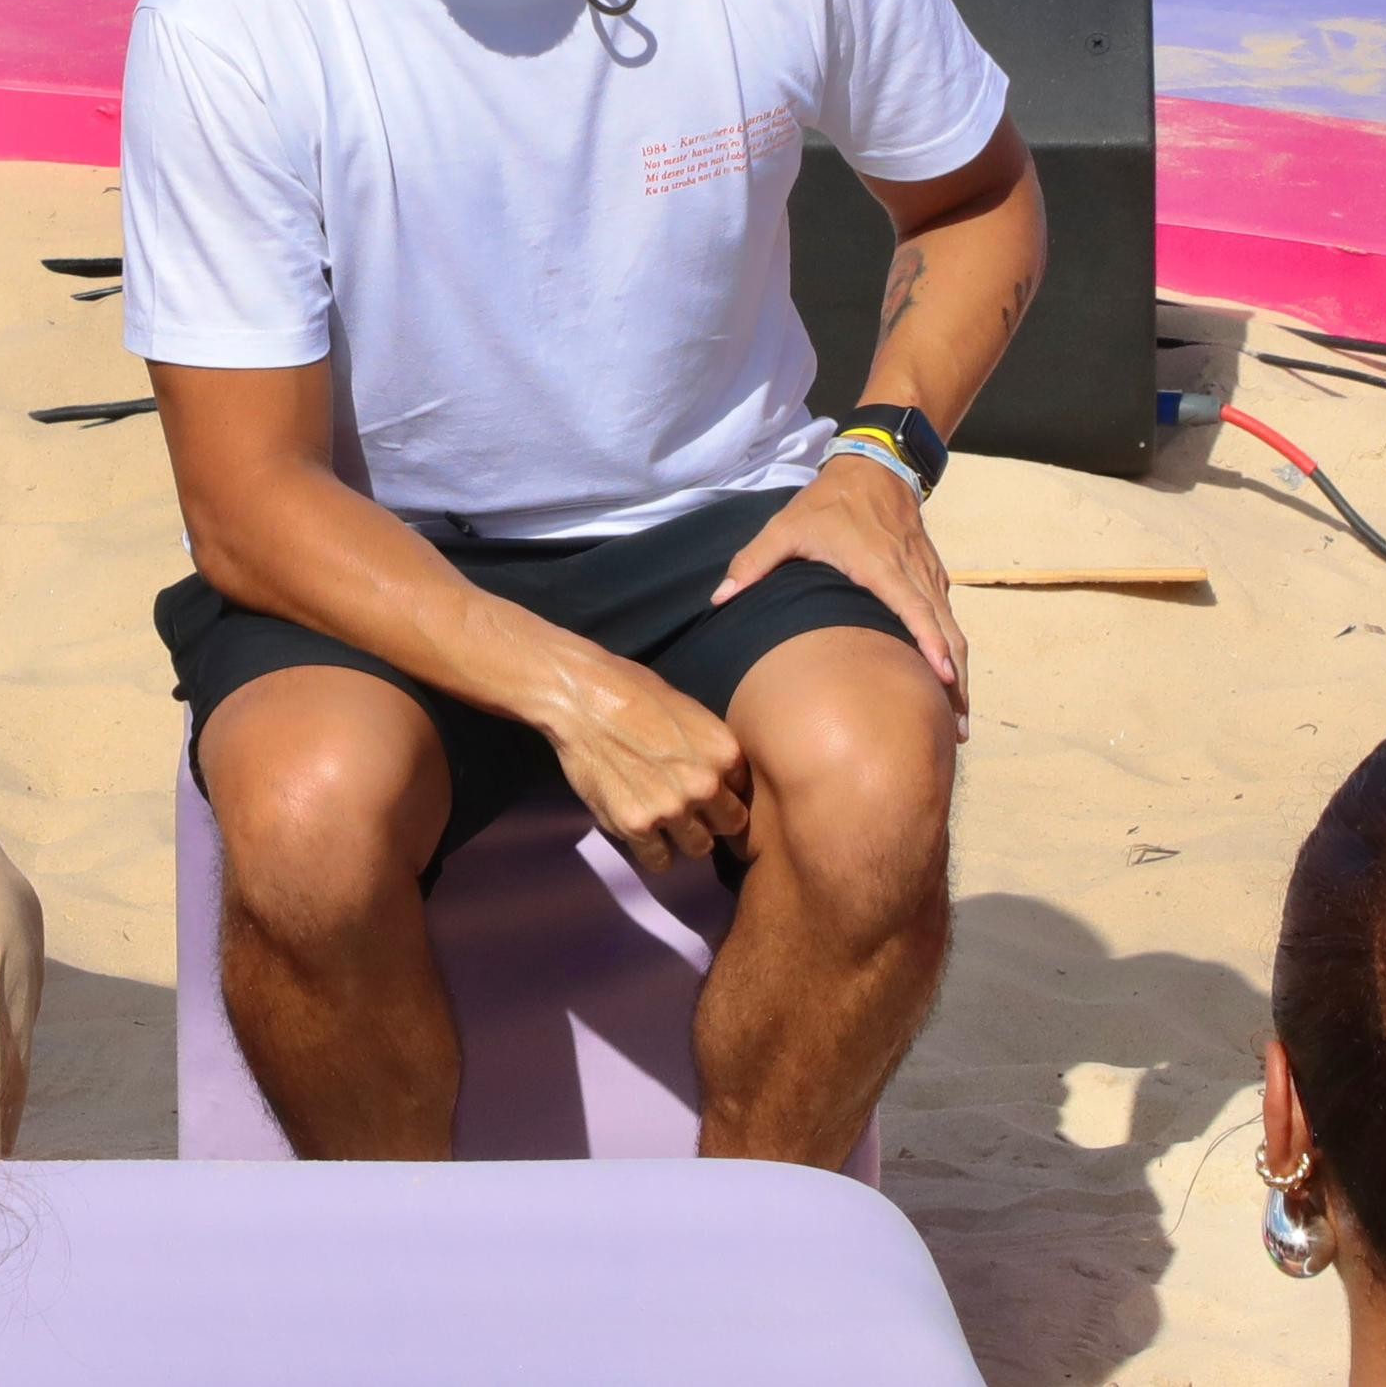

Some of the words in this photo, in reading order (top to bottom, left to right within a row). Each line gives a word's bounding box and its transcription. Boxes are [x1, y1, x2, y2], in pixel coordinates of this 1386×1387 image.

[641, 142, 668, 157] 1984
[645, 173, 659, 183] Mi
[645, 186, 658, 196] Ku
